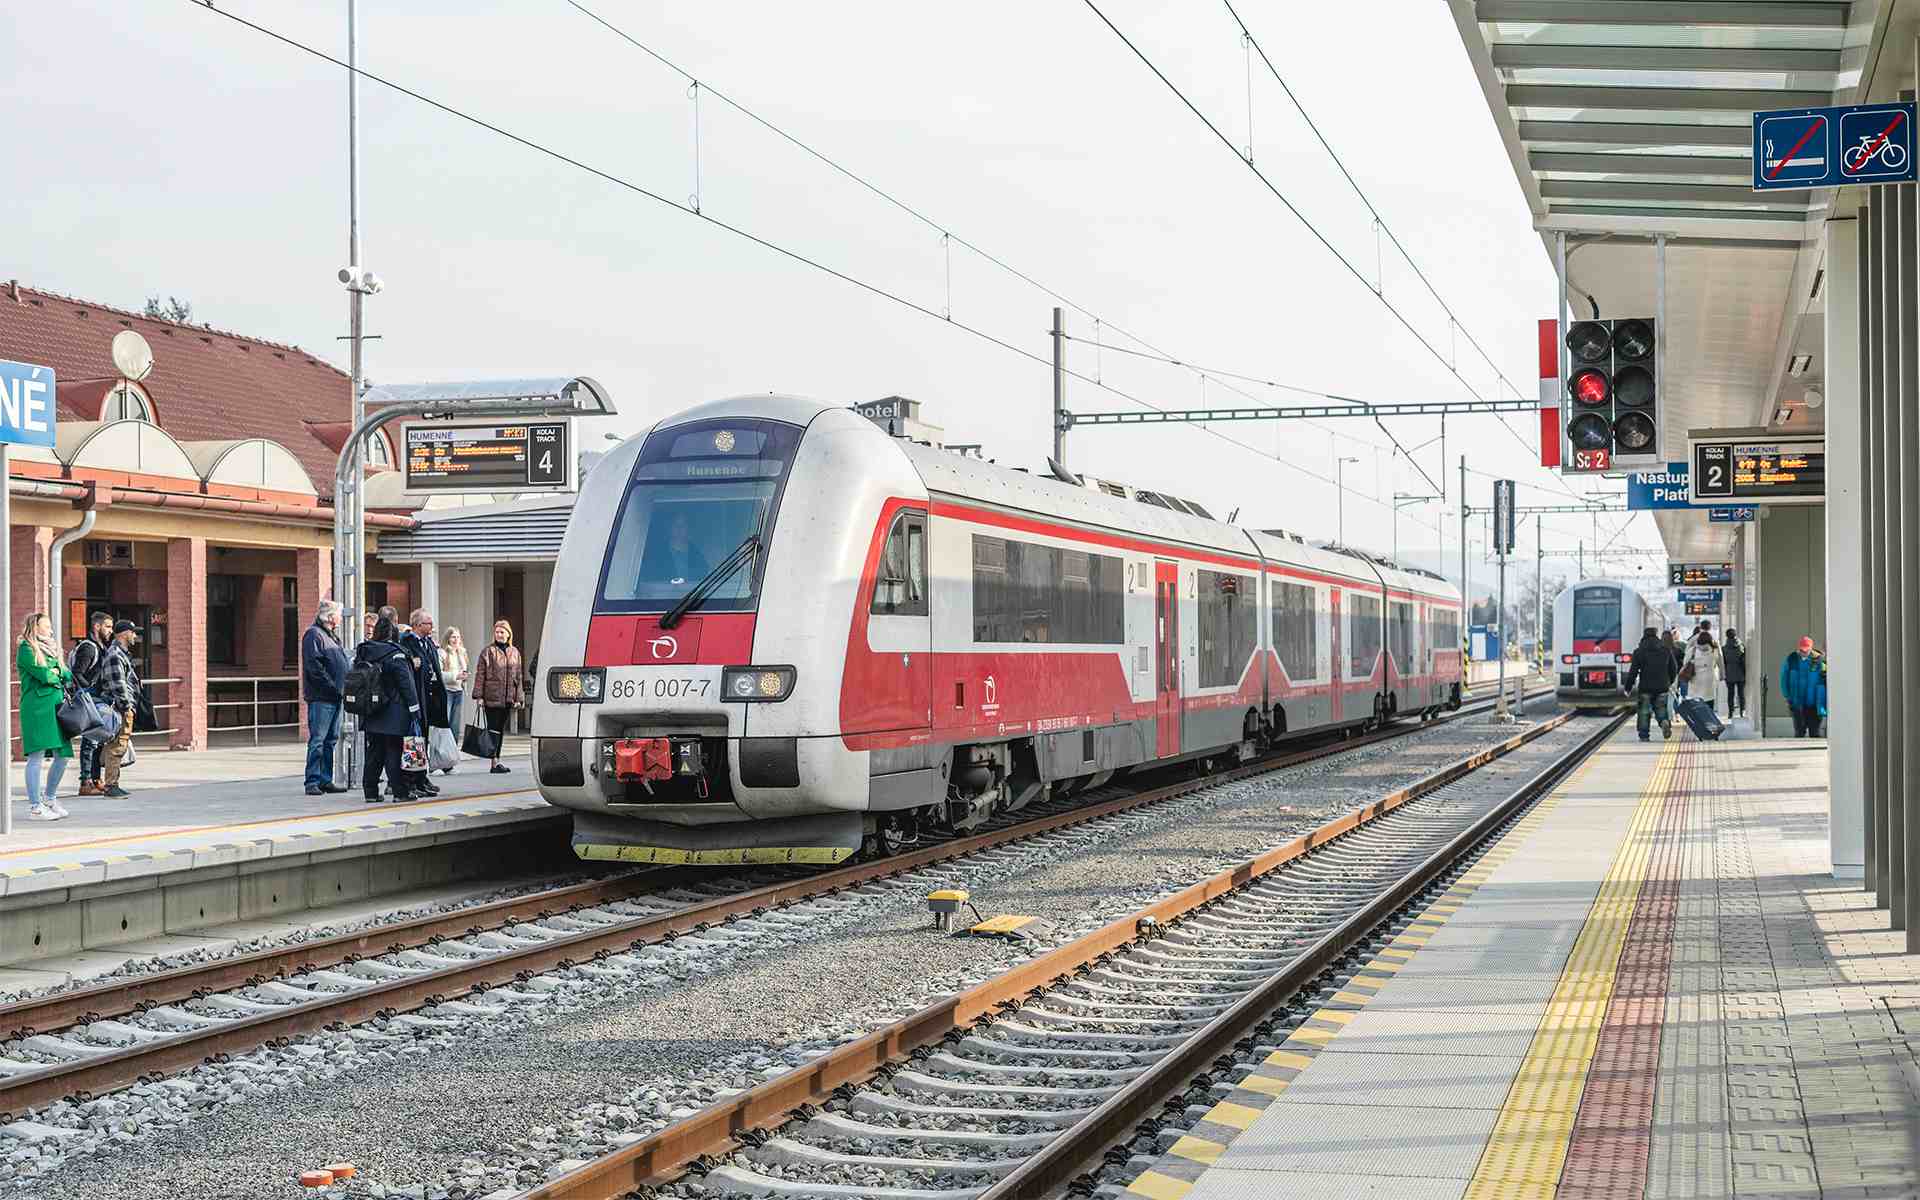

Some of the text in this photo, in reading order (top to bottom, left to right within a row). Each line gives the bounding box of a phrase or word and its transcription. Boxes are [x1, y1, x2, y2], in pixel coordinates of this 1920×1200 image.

[538, 449, 553, 474] 4
[1576, 451, 1604, 468] Sc 2
[1708, 466, 1722, 487] 2
[1127, 563, 1135, 594] 2
[1673, 572, 1681, 585] 2
[611, 679, 712, 698] 861 007-7
